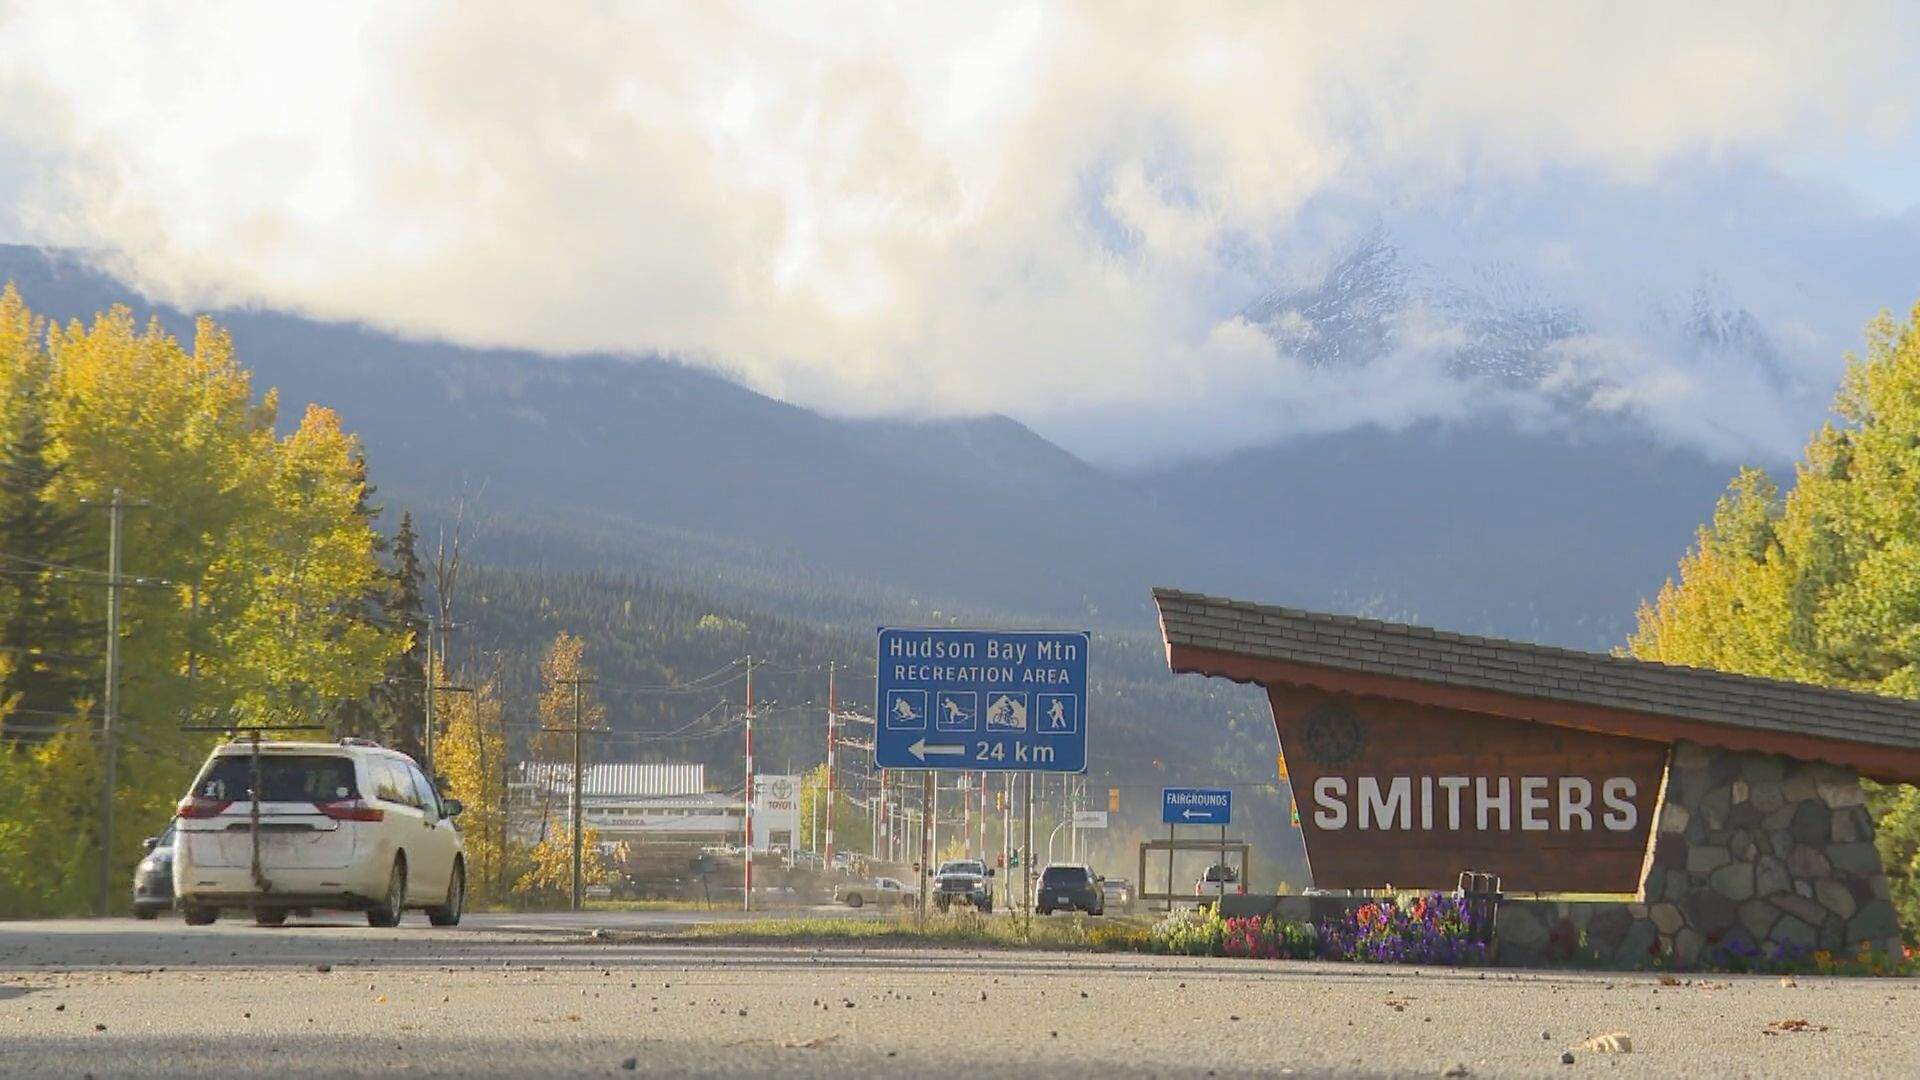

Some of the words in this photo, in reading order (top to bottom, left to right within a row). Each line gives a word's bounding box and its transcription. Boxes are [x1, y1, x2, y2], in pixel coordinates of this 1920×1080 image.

[890, 638, 975, 658] Hudson
[987, 639, 1027, 664] Bay
[1037, 641, 1076, 660] Mtn
[895, 665, 1013, 682] RECREATION
[1022, 669, 1069, 683] AREA
[976, 741, 1005, 761] 24
[1015, 742, 1054, 762] km
[1166, 793, 1228, 806] FAIRGROUNDS
[1313, 776, 1638, 831] SMITHERS
